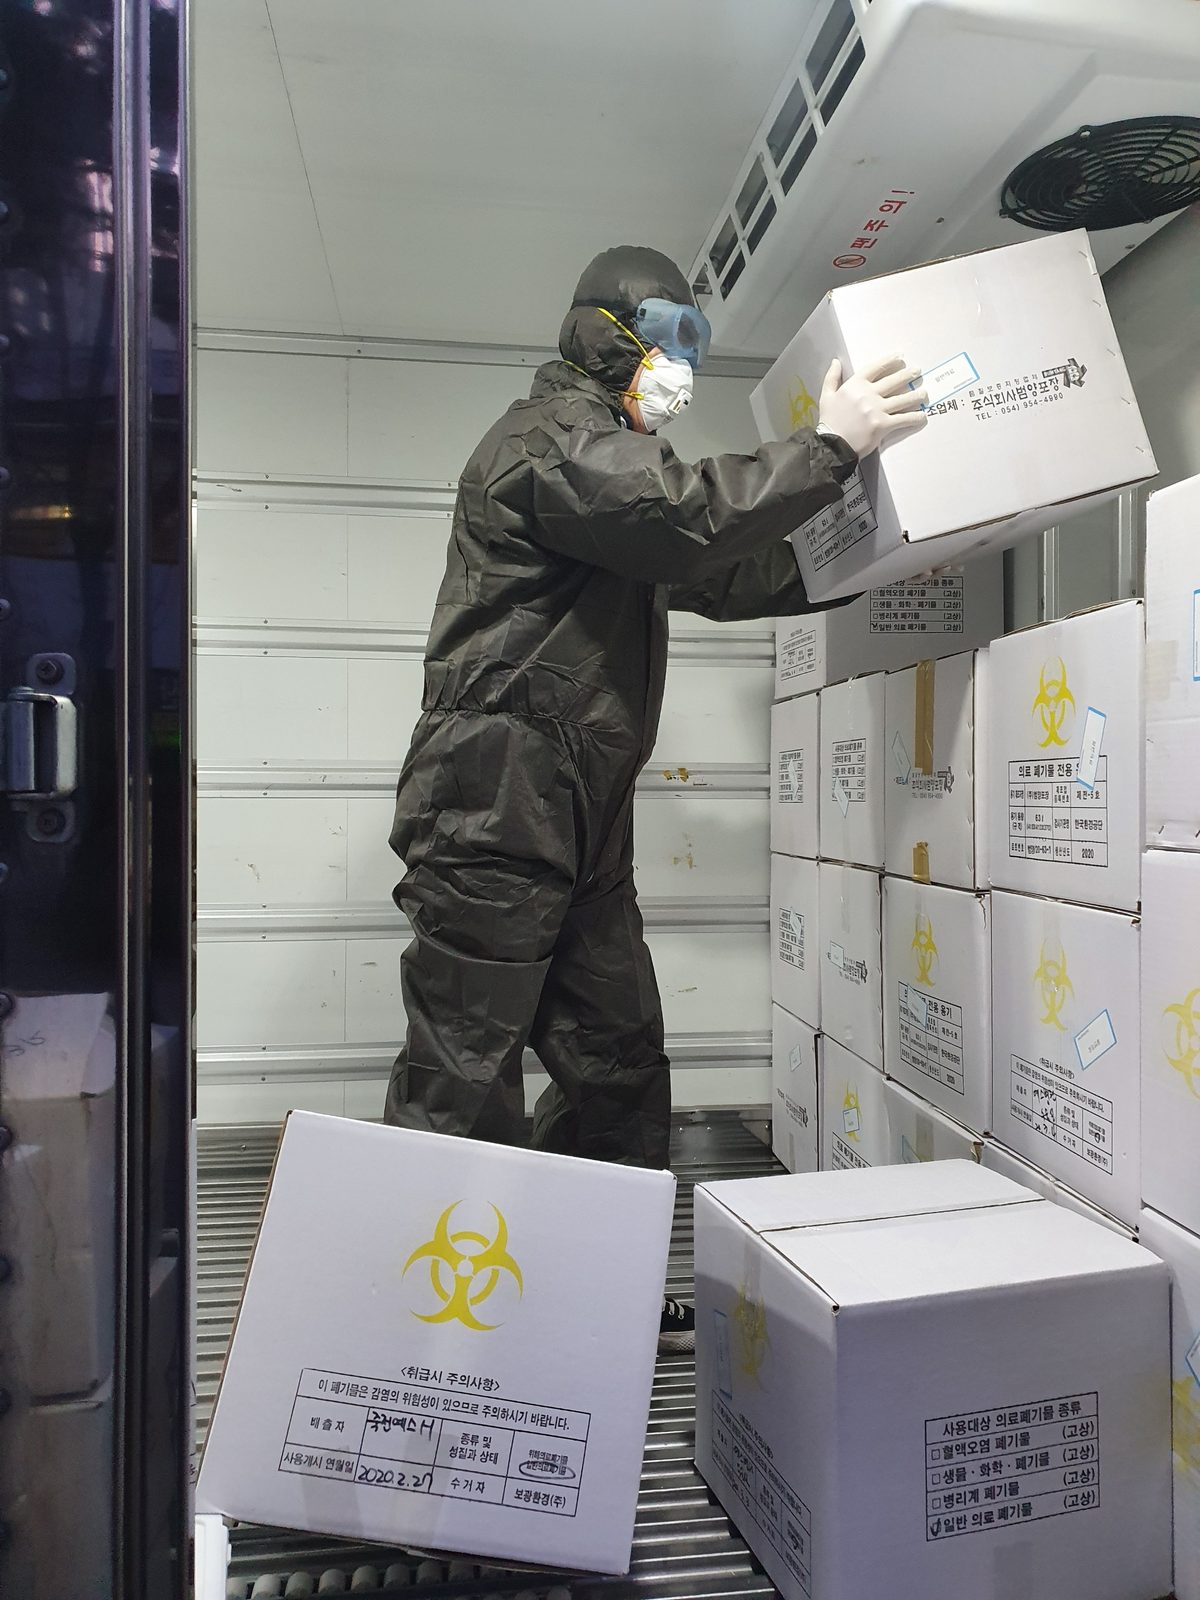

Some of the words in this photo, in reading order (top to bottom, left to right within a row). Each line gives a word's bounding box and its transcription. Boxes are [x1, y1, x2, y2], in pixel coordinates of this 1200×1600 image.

[922, 399, 958, 417] 조업체
[975, 411, 992, 421] TEL
[1018, 764, 1032, 778] 의료
[1034, 764, 1054, 778] 폐기물
[1057, 763, 1073, 777] 전용
[401, 1366, 443, 1384] <취급시
[446, 1372, 500, 1392] 주의사항>
[318, 1379, 328, 1393] 이
[330, 1381, 369, 1399] 폐기물은
[371, 1387, 400, 1404] 감염의
[402, 1391, 439, 1410] 위험성이
[442, 1398, 479, 1416] 있으므로
[481, 1404, 529, 1425] 주의하시기
[530, 1412, 570, 1431] 바랍니다.
[943, 1415, 991, 1437] 사용대상
[995, 1404, 1054, 1428] 의료폐기물
[1058, 1400, 1082, 1418] 종류
[460, 1432, 479, 1446] 종류
[482, 1435, 492, 1449] 및
[943, 1438, 991, 1461] 혈액오염
[995, 1431, 1031, 1450] 폐기물
[1062, 1420, 1095, 1439] (고상)
[283, 1452, 323, 1469] 사용개시
[325, 1457, 355, 1474] 연월일
[449, 1445, 477, 1462] 성질과
[479, 1451, 499, 1465] 상태
[943, 1467, 967, 1485] 생물
[979, 1460, 1003, 1477] 화학
[1015, 1451, 1050, 1471] 폐기물
[1062, 1444, 1095, 1463] (고상)
[514, 1488, 566, 1509] 보광환경(주)
[943, 1488, 980, 1510] 병리계
[984, 1481, 1020, 1501] 폐기물
[1063, 1467, 1095, 1486] (고상)
[943, 1514, 968, 1533] 일반
[971, 1510, 995, 1527] 의료
[997, 1501, 1033, 1521] 폐기물
[1063, 1490, 1096, 1509] (고상)
